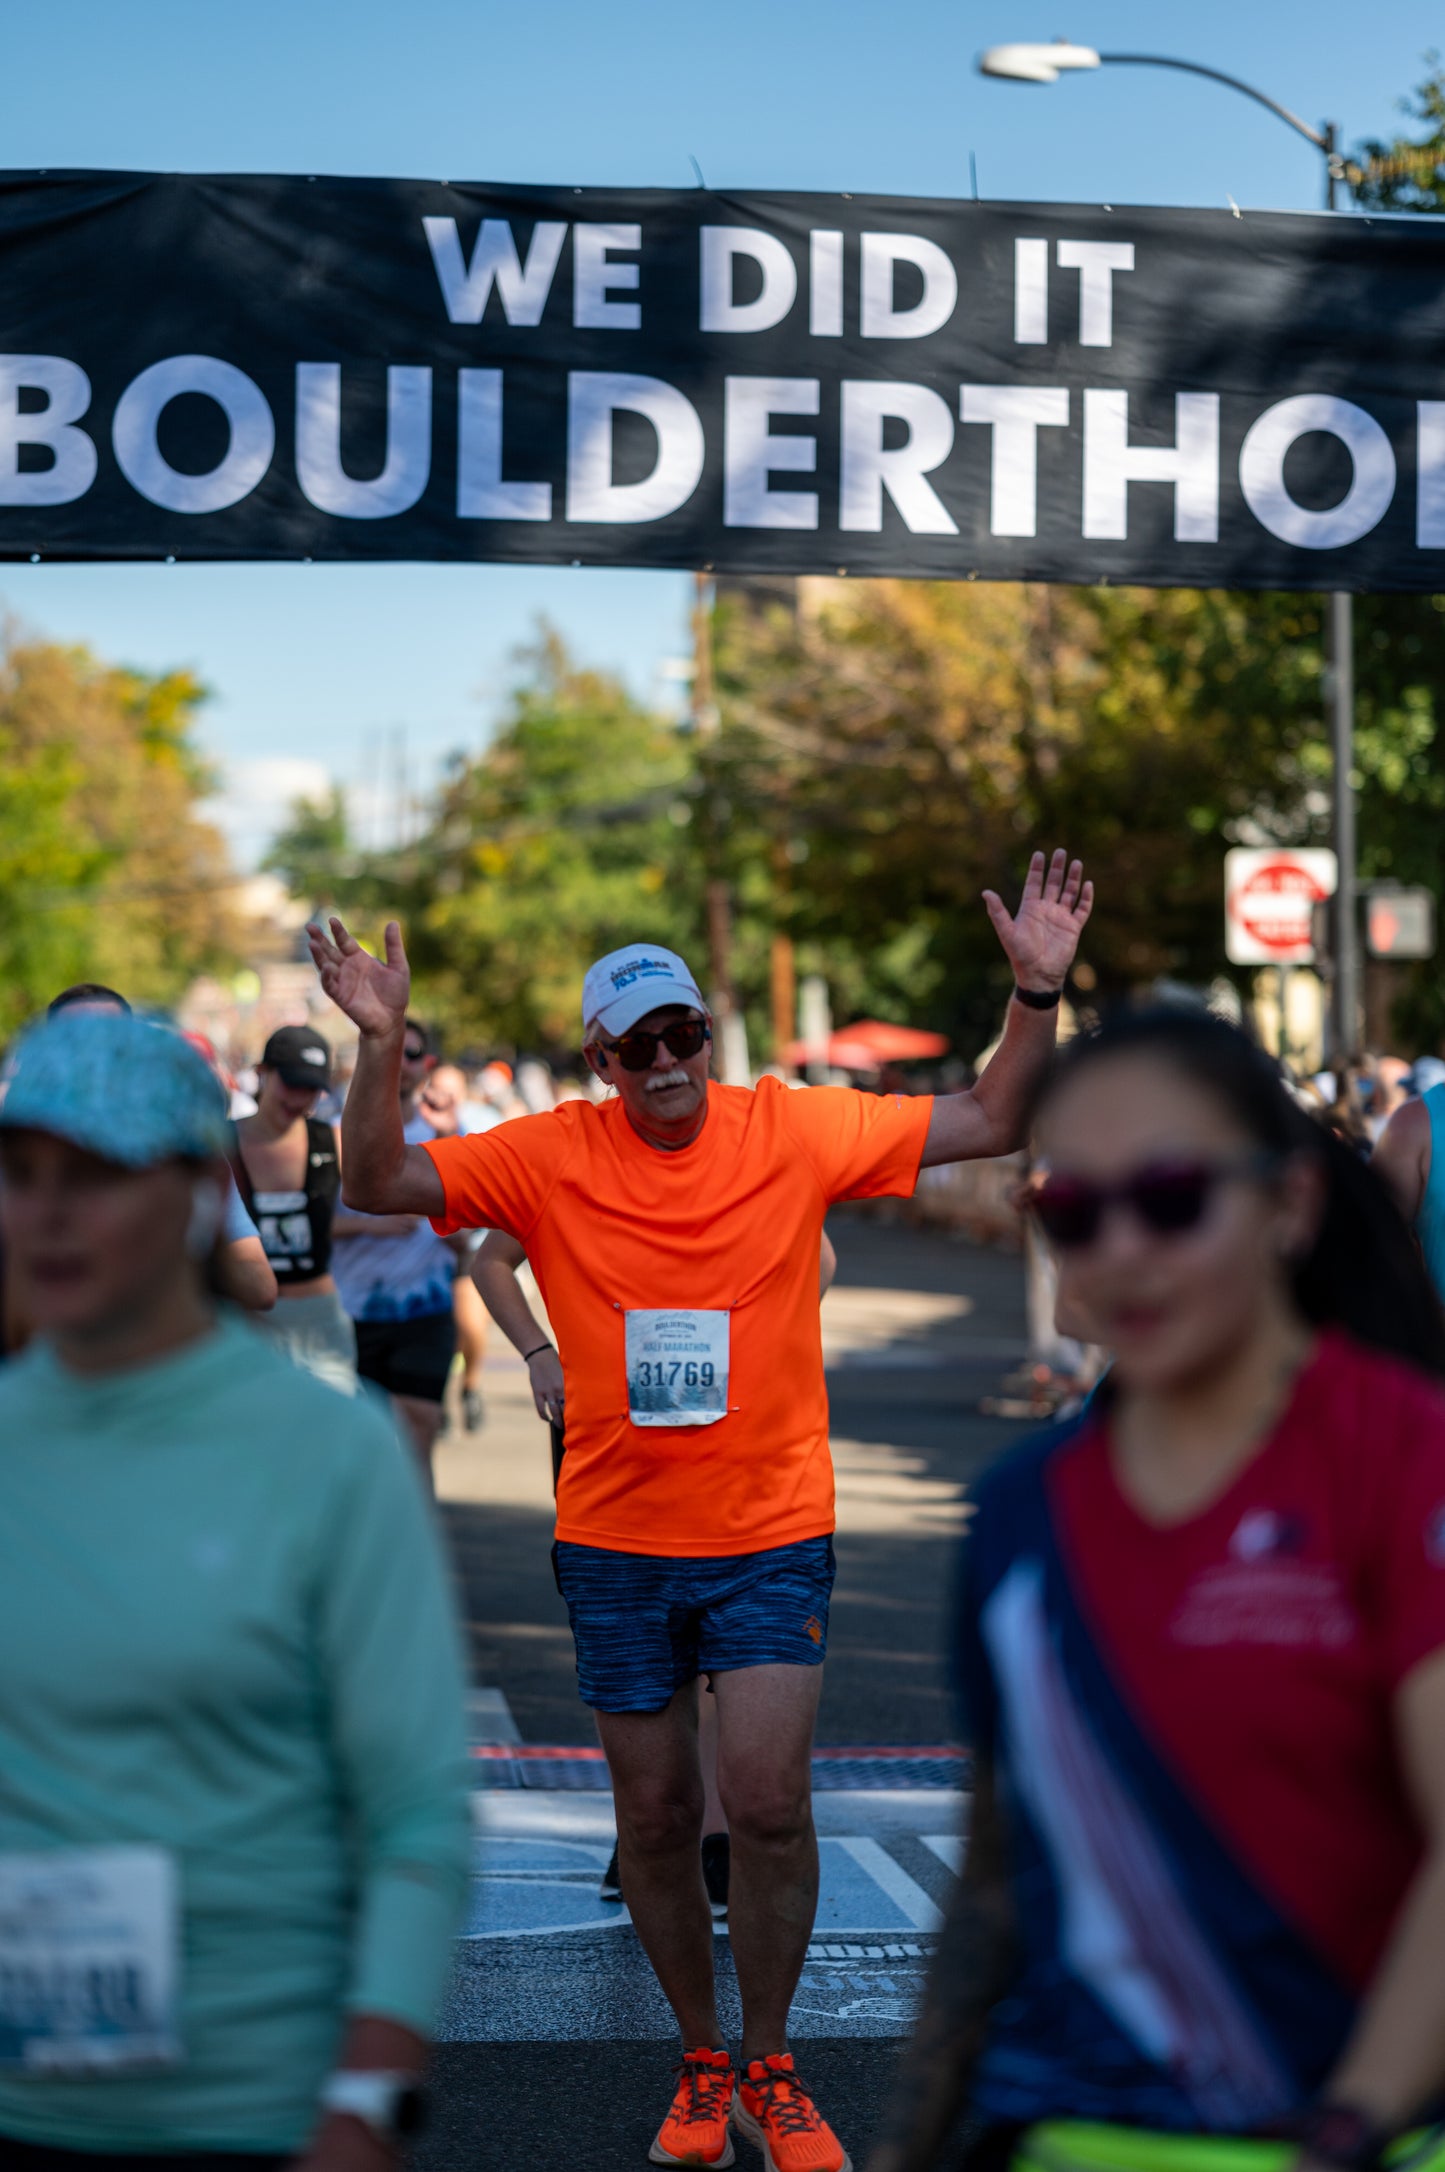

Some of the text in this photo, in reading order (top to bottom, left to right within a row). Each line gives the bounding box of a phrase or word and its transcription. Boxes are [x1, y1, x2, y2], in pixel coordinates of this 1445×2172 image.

[422, 216, 1135, 347] WE DID IT
[0, 354, 1445, 549] BOULDERTHO
[612, 971, 638, 992] 70.3
[640, 1361, 715, 1387] 31769
